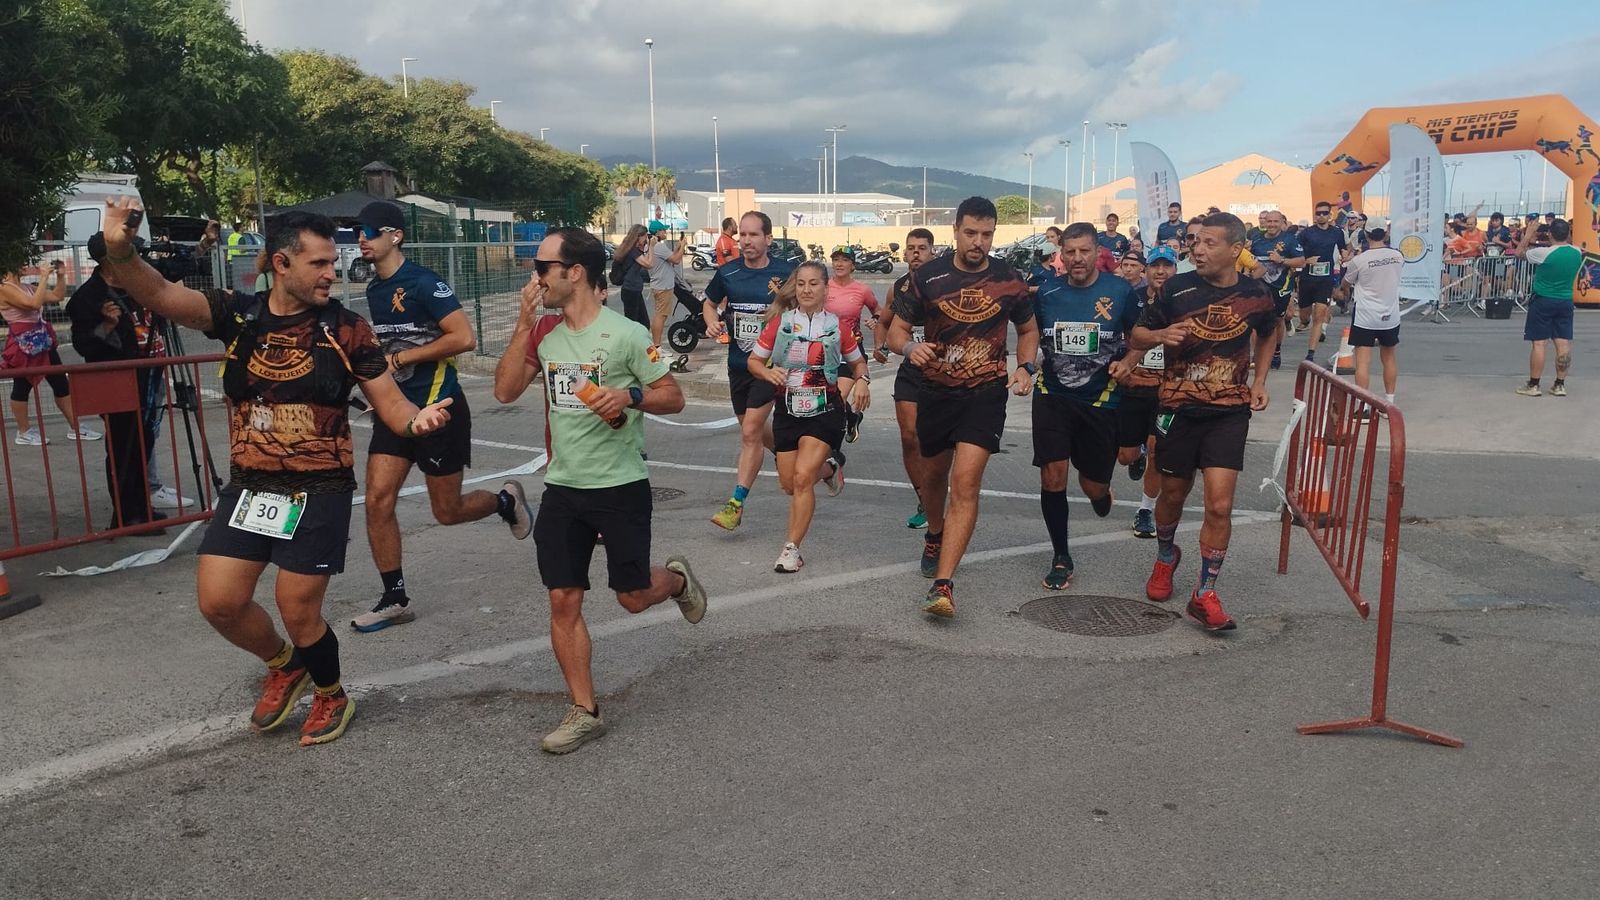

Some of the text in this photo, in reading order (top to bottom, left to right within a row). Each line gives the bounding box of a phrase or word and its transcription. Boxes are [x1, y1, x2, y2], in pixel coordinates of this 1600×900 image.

[1426, 109, 1520, 128] MIS TIEMPOS
[1450, 120, 1517, 142] CHIP
[972, 305, 1000, 320] FUERTES
[741, 324, 758, 334] 102
[1217, 324, 1247, 338] FUERTES
[1064, 335, 1086, 345] 148
[1150, 352, 1163, 361] 29
[259, 368, 276, 379] LOS
[798, 399, 811, 409] 36
[256, 503, 278, 520] 30
